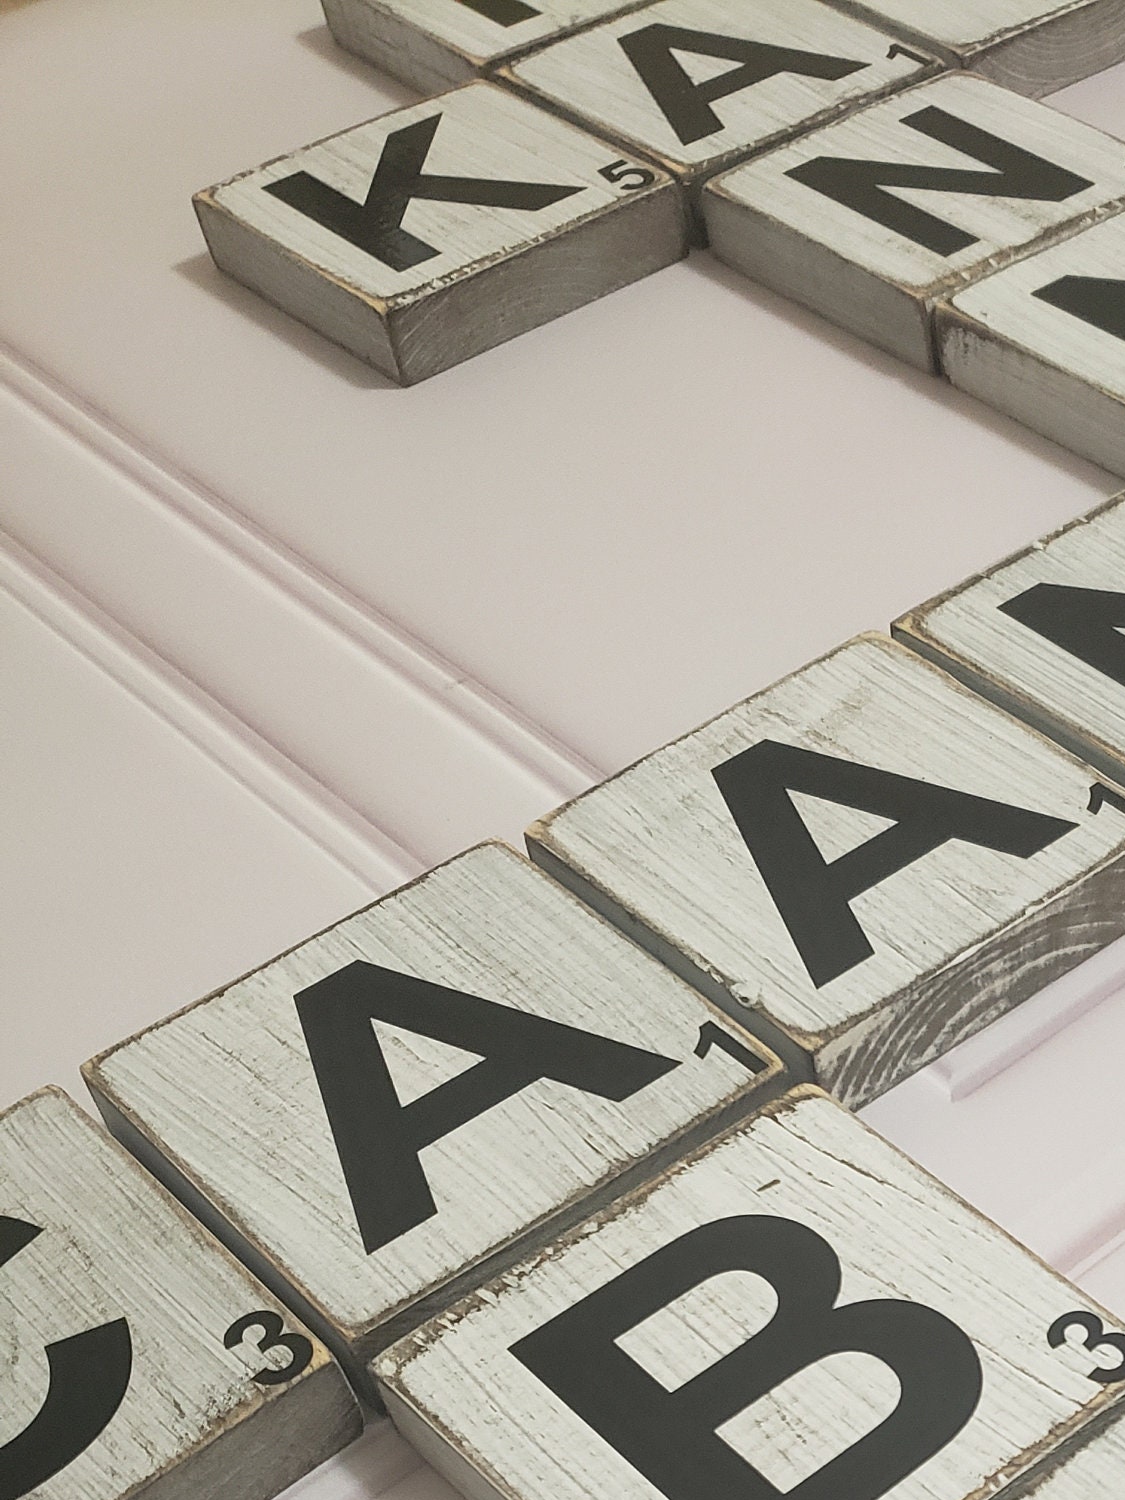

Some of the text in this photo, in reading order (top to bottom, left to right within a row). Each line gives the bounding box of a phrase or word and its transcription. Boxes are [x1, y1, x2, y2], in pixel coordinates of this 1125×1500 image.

[887, 44, 934, 68] 1
[598, 160, 654, 190] 5
[694, 1021, 769, 1074] 1
[224, 1311, 313, 1385] 3
